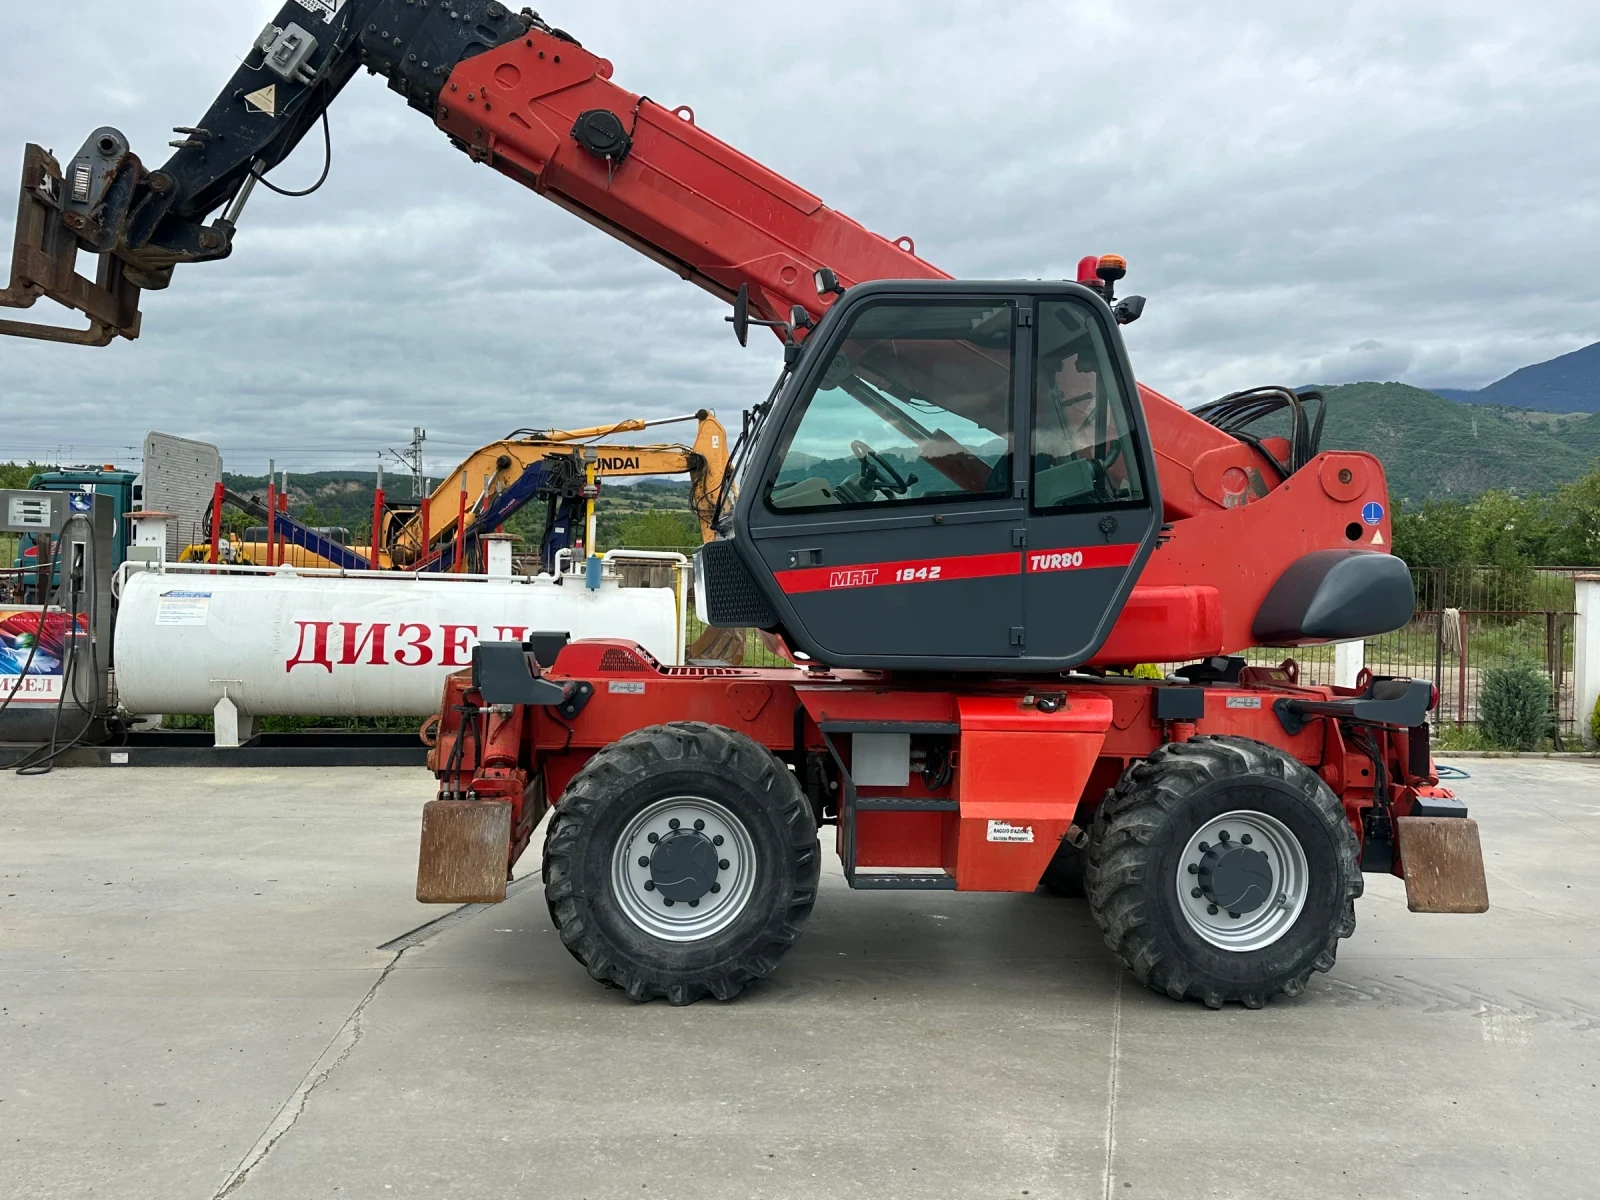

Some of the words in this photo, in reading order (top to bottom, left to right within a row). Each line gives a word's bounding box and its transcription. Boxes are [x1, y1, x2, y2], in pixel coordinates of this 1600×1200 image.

[594, 457, 640, 470] UNDAI
[830, 569, 879, 587] MRT
[896, 566, 941, 582] 1842
[1031, 551, 1083, 570] TURBO
